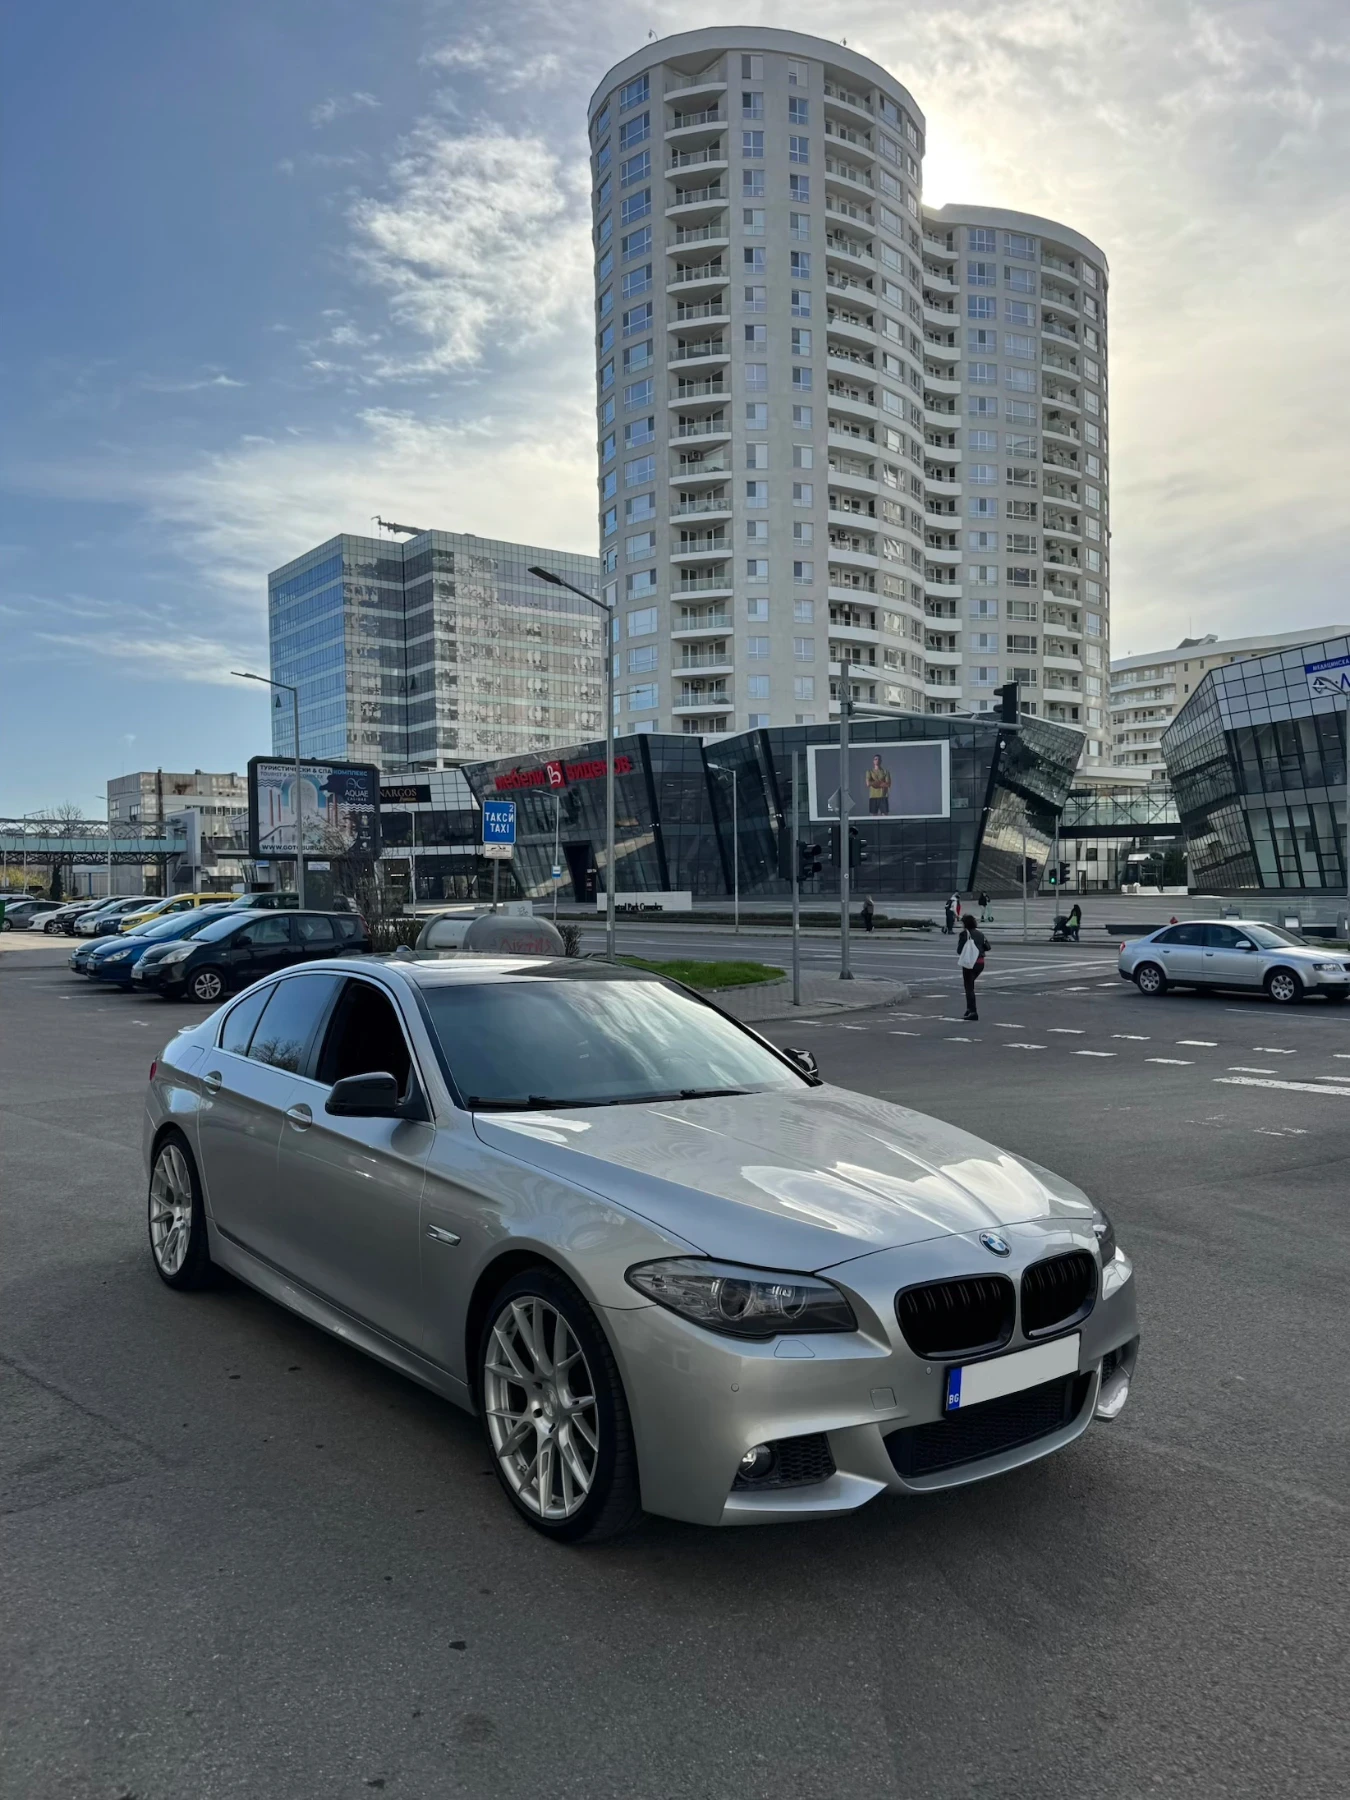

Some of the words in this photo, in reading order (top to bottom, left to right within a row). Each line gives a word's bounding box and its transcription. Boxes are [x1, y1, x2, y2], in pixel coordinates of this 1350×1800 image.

[260, 764, 311, 773] ТУРИСТИЧСКИ
[495, 767, 546, 791] мебели
[344, 789, 369, 798] AQUAE
[509, 804, 514, 813] 2
[485, 812, 514, 823] ТАКСИ
[490, 823, 510, 834] TAXI
[628, 903, 639, 912] Park
[949, 1393, 960, 1404] BG
